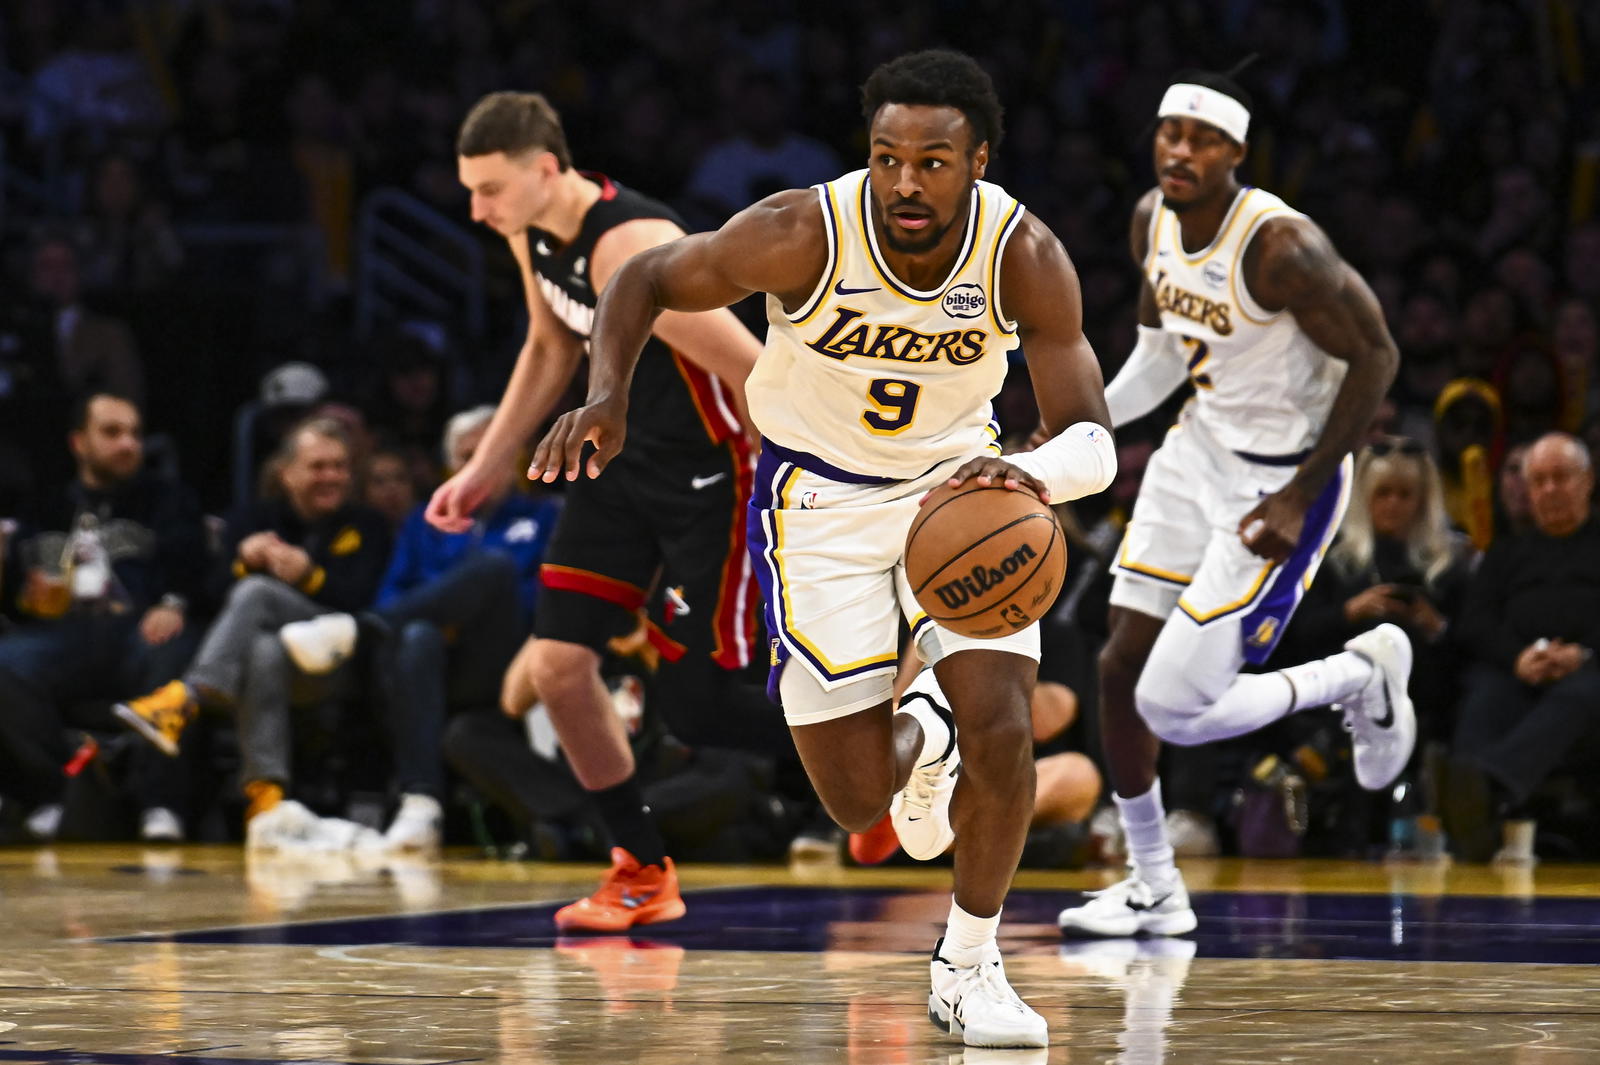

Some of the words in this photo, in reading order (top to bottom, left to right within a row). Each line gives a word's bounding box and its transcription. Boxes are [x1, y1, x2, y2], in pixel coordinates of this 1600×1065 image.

[946, 293, 985, 309] bibigo
[804, 304, 989, 366] LAKERS
[1181, 333, 1215, 390] 2
[859, 378, 923, 437] 9
[933, 543, 1037, 610] Wilson
